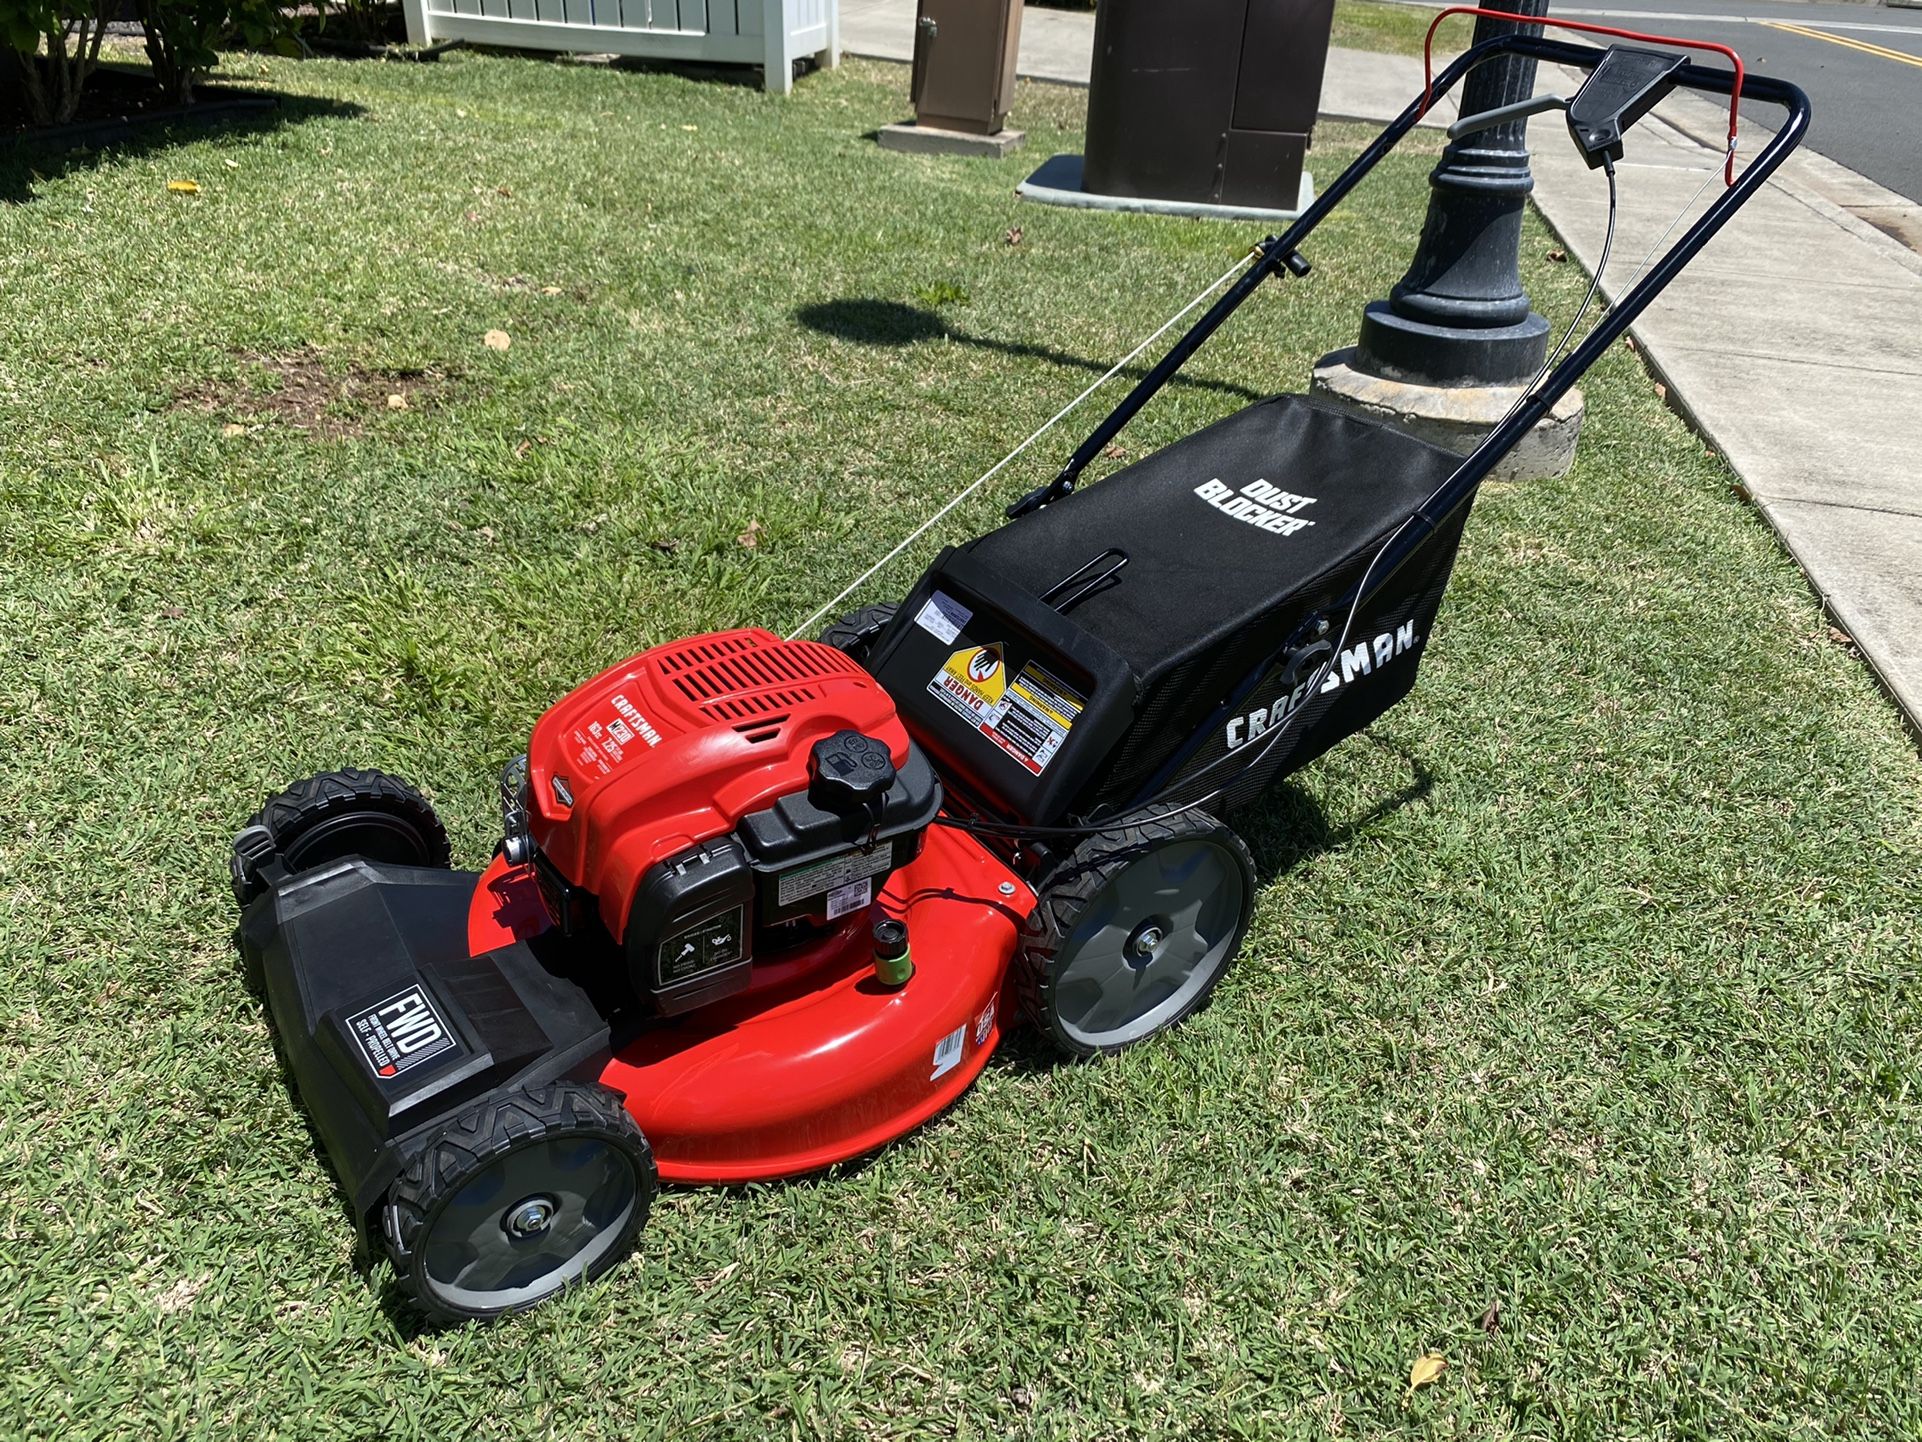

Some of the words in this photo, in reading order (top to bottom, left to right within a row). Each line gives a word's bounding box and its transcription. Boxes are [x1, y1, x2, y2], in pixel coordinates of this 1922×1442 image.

[1193, 478, 1309, 537] BLOCKER
[1240, 478, 1318, 514] DUST
[943, 675, 984, 711] DANGER
[606, 718, 634, 745] M230
[611, 694, 663, 747] CRAFTSMAN
[1006, 743, 1027, 760] DANGER
[356, 1019, 372, 1033] SELF
[365, 1035, 391, 1067] PROPELLED
[378, 993, 442, 1054] FWD
